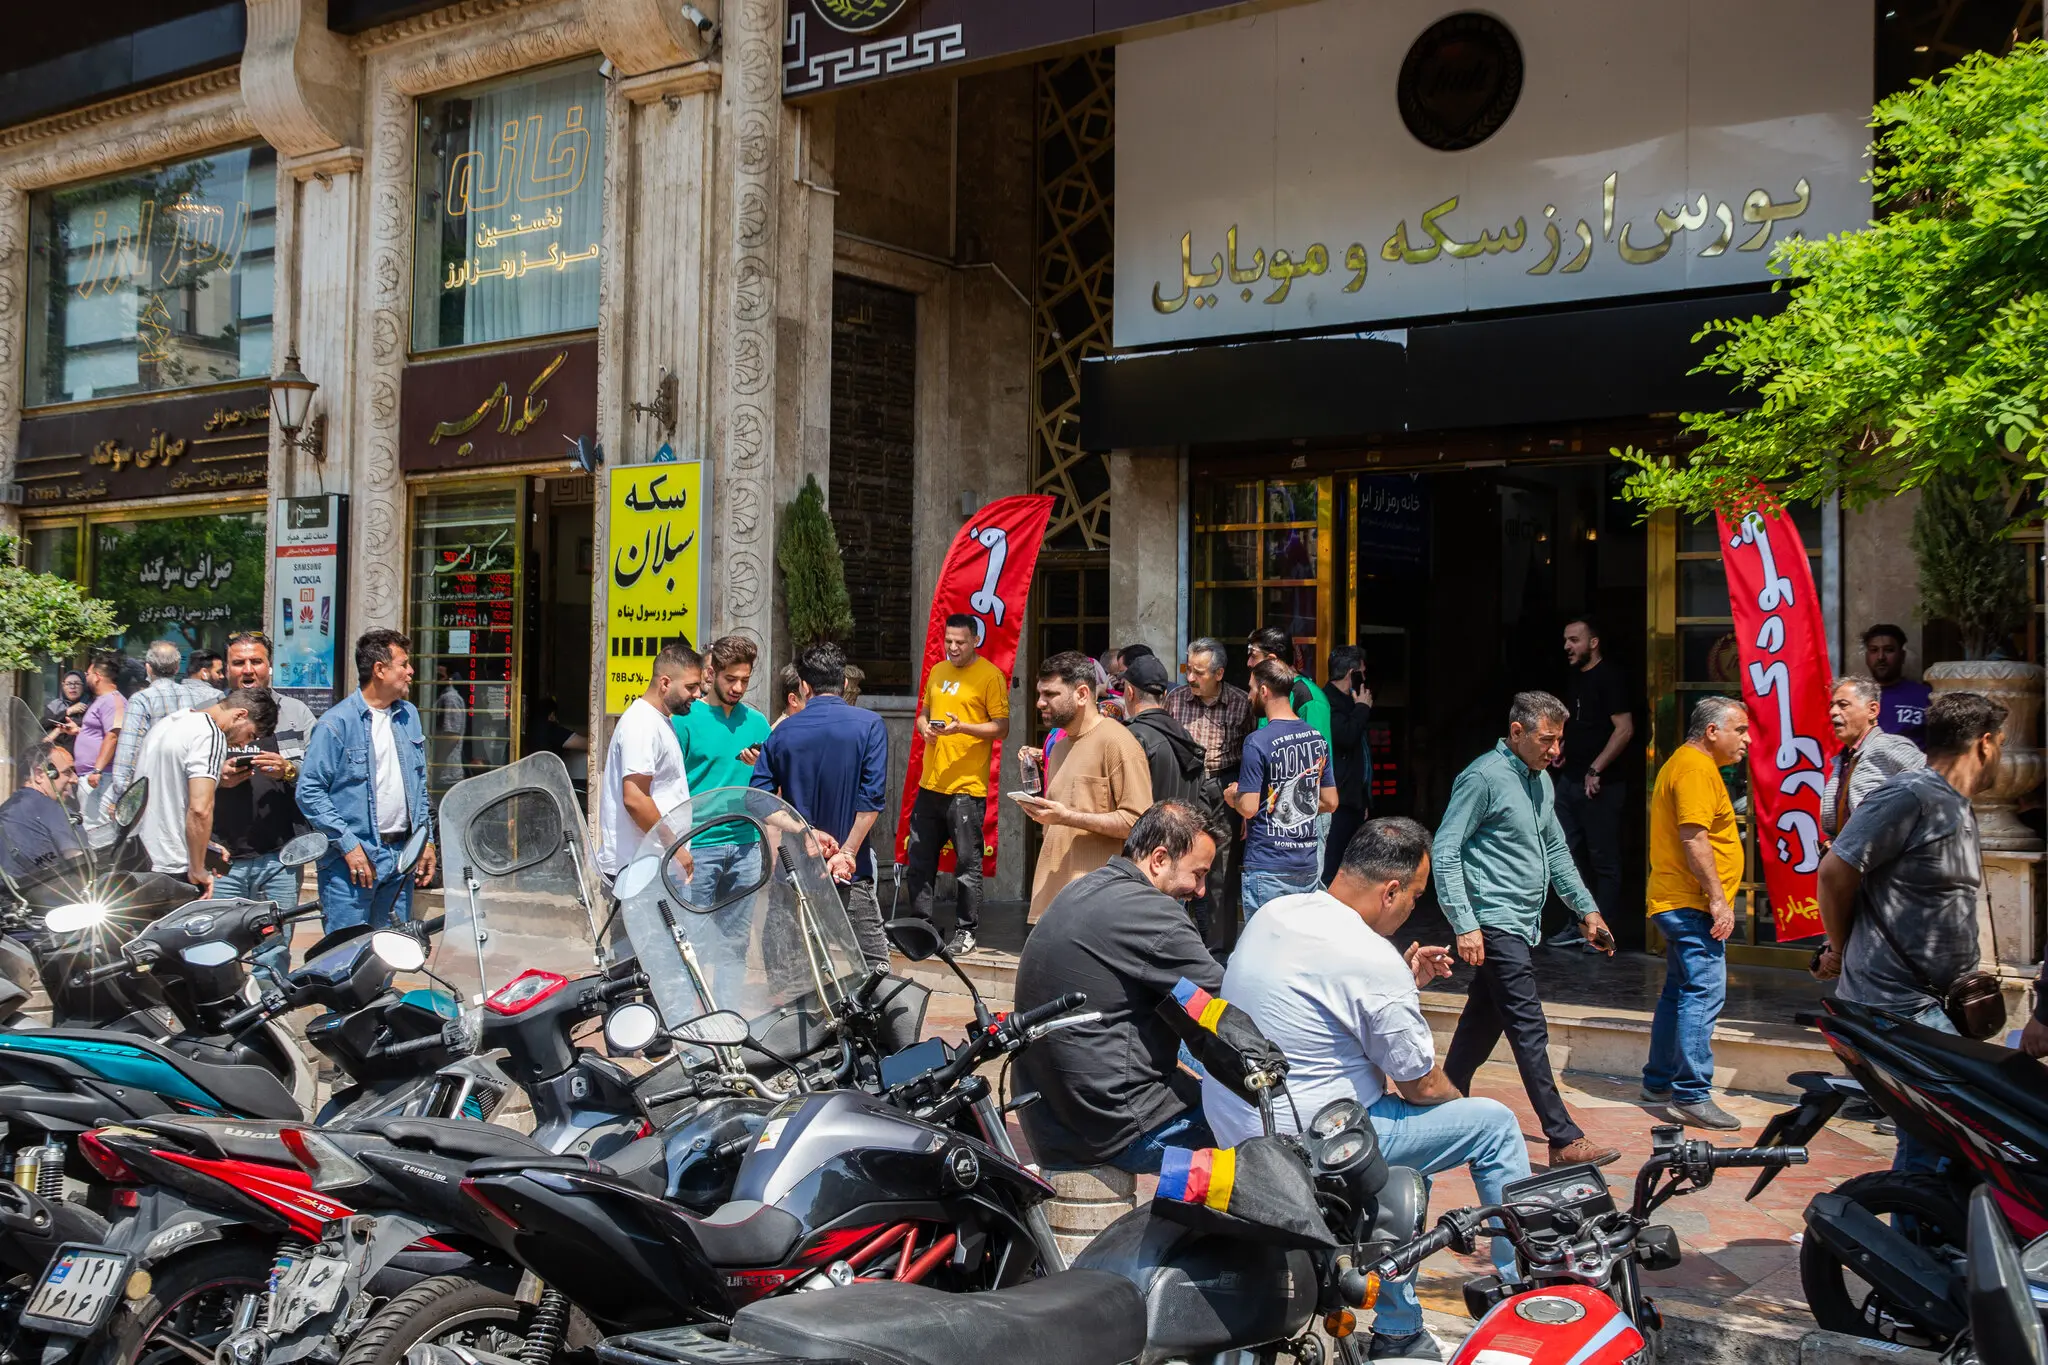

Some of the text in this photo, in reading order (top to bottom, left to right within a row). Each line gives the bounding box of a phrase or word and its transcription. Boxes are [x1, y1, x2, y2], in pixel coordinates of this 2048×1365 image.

[447, 105, 591, 216] خانه
[476, 206, 563, 248] نخستین
[1151, 171, 1811, 315] بورس ارز سکه و موبایل
[517, 241, 598, 277] مرکز
[89, 427, 186, 472] صرافی سوگند
[624, 474, 687, 512] سکه
[1401, 492, 1420, 511] خانه
[294, 563, 322, 571] SAMSUNG
[614, 521, 695, 593] سبلان
[140, 553, 232, 590] صرافی سوگند
[293, 575, 321, 584] NOKIA
[617, 603, 688, 621] خسرو رسول پناه
[611, 672, 627, 683] 78B
[1897, 708, 1923, 725] 123
[1284, 733, 1294, 741] NOT
[1777, 895, 1819, 931] چهارم
[224, 1128, 280, 1139] Wav
[2001, 1141, 2039, 1161] 150
